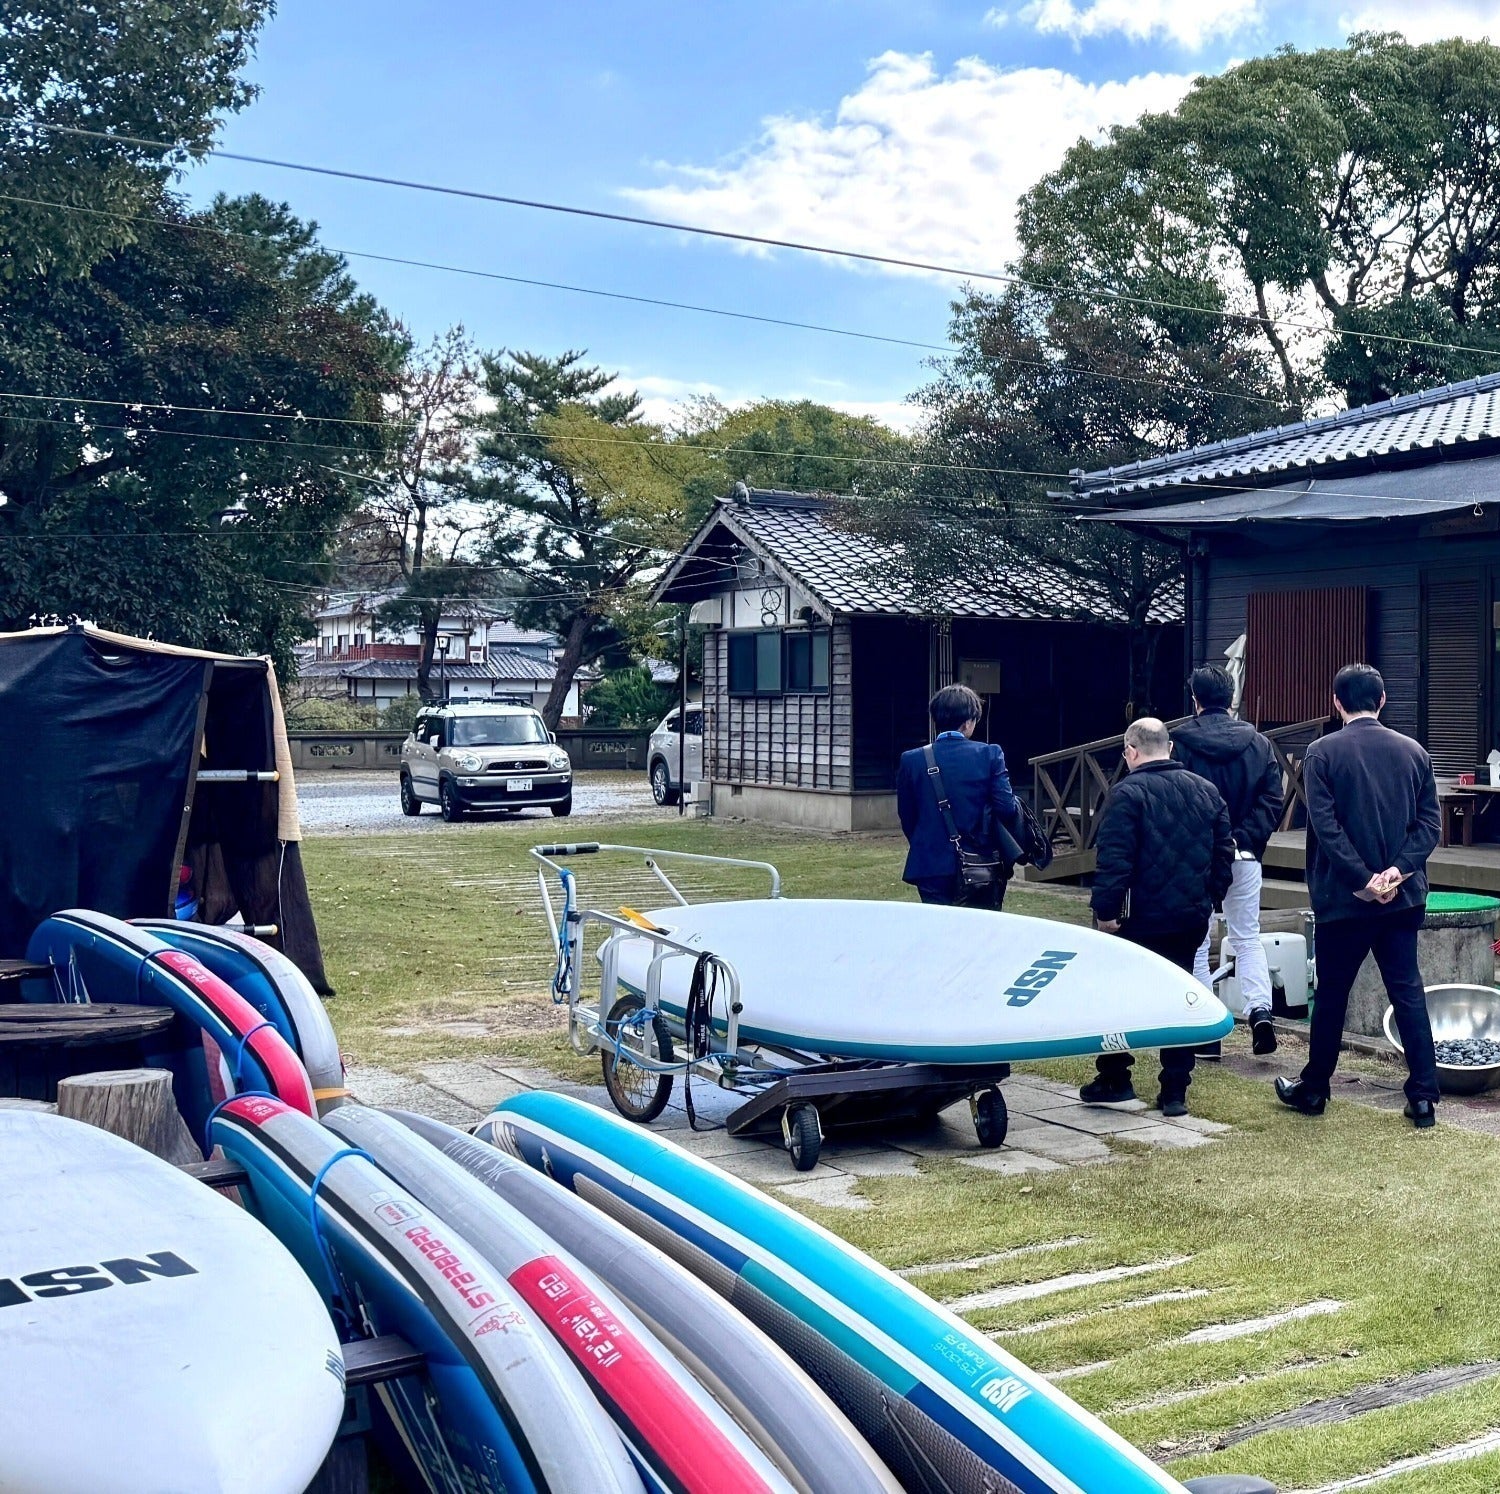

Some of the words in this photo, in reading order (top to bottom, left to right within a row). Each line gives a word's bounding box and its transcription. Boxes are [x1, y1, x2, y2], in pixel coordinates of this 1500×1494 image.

[1003, 950, 1078, 1007] NSP
[1100, 1032, 1131, 1051] NSP
[0, 1250, 200, 1308] NS
[405, 1226, 495, 1309] STARBOARD
[538, 1272, 571, 1302] iGO
[979, 1376, 1033, 1414] NSP
